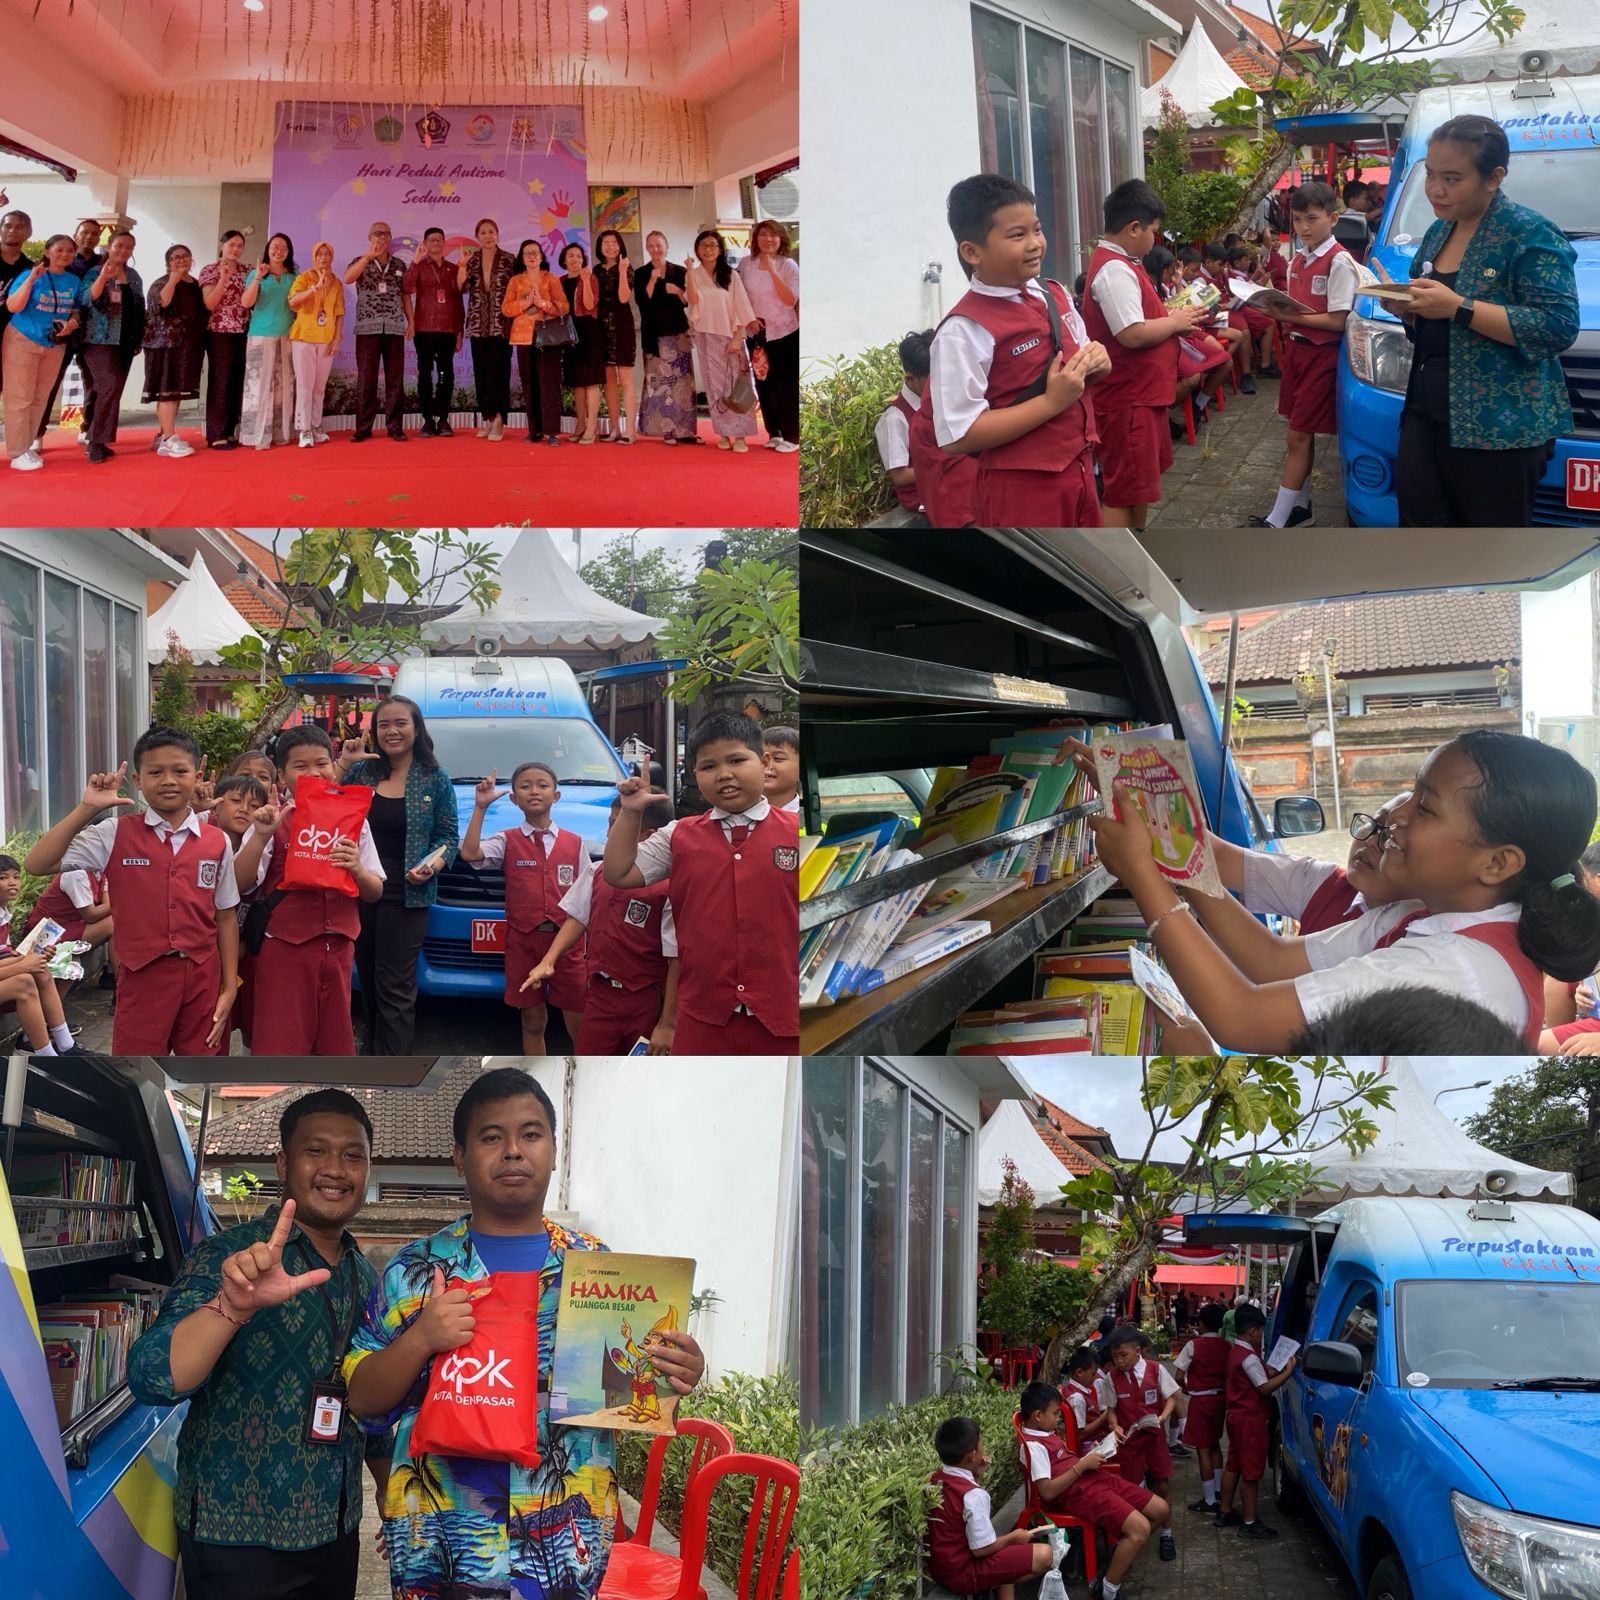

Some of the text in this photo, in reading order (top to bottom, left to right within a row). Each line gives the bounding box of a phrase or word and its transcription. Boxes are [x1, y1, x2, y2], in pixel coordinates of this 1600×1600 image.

[356, 163, 506, 178] Hari Peduli Autisme
[402, 189, 462, 204] Sedunia
[1013, 338, 1039, 355] ADITYA
[439, 687, 547, 702] Perpustakaan
[294, 851, 310, 859] KOTA
[475, 922, 497, 942] DK
[1441, 1237, 1595, 1258] Perpustakaan
[570, 1280, 658, 1303] HAMKA
[569, 1299, 635, 1313] PUJANGGA BESAR
[456, 1393, 516, 1408] DENPASAR
